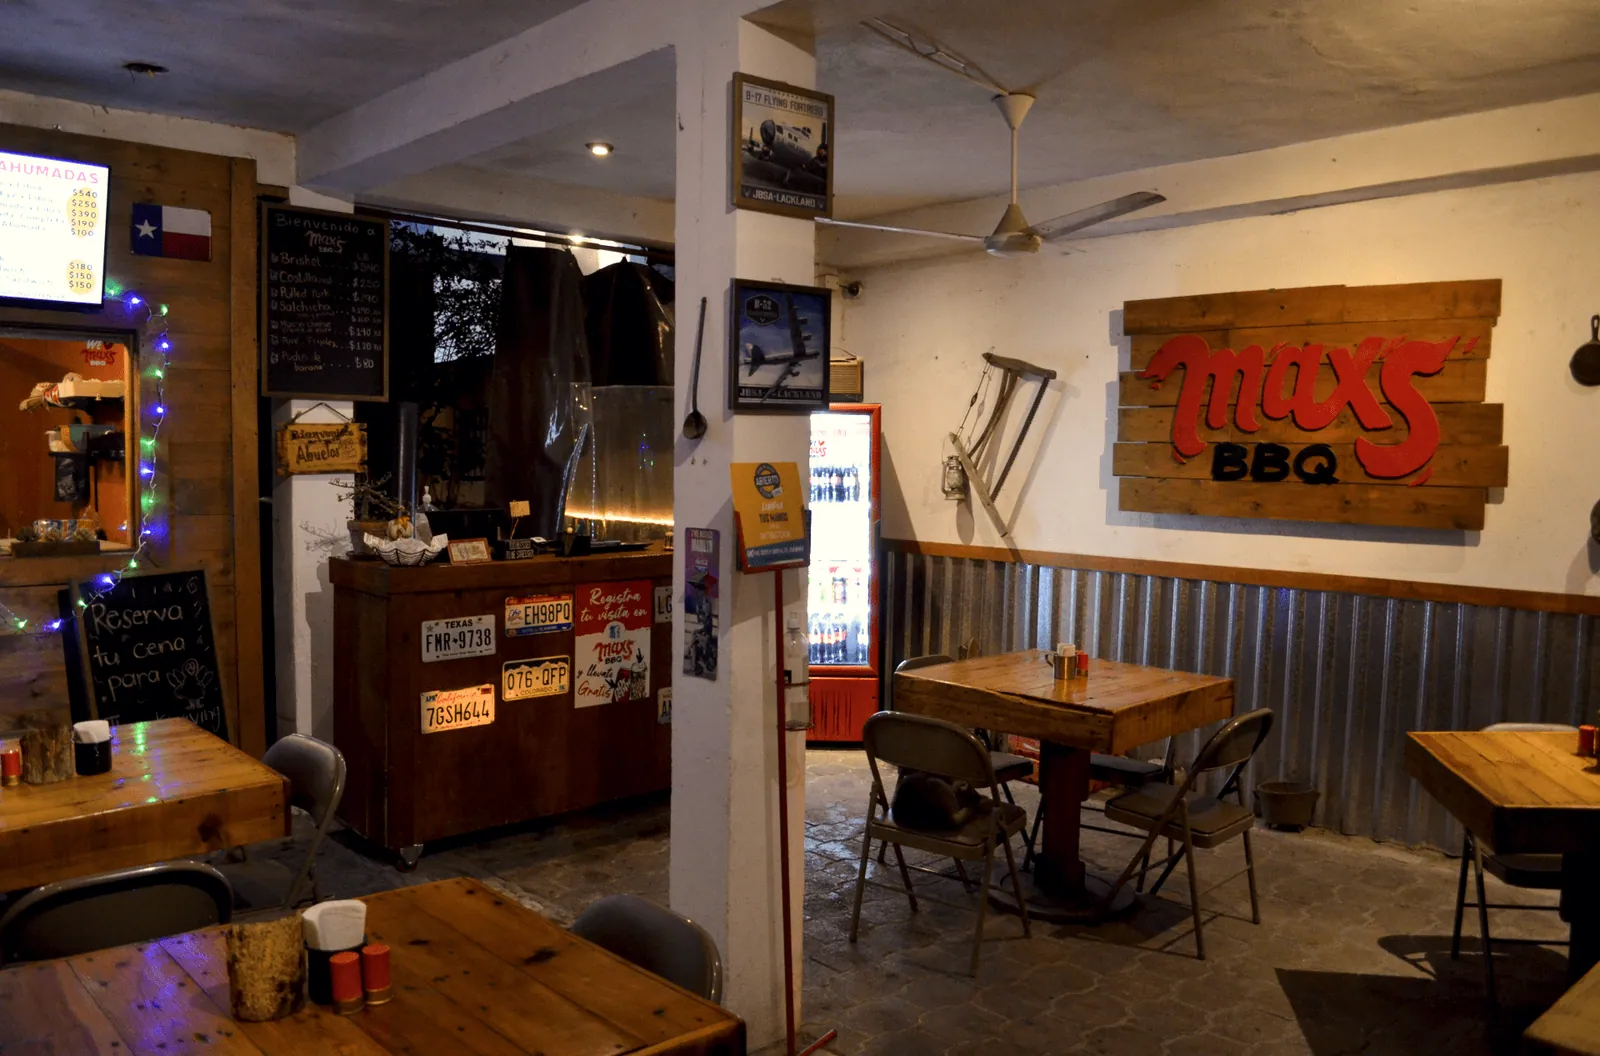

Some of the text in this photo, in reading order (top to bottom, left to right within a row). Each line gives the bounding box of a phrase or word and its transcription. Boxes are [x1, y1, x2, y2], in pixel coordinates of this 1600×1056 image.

[745, 90, 825, 117] B-17 FLYING FORTRESS
[0, 160, 99, 185] AHUMADAS
[73, 188, 98, 198] $540
[752, 190, 816, 208] JBSA-LACKLAND
[72, 199, 97, 209] $250
[71, 209, 97, 219] $390
[71, 218, 94, 228] $190
[274, 213, 375, 236] Bienvenido a
[71, 228, 94, 237] $100
[69, 262, 93, 271] $180
[280, 252, 320, 267] Brisket
[69, 271, 92, 280] $150
[68, 280, 92, 289] $150
[280, 301, 332, 313] Salchicha
[354, 356, 375, 369] $80
[1211, 442, 1339, 484] BBQ
[590, 587, 641, 609] Registra
[91, 603, 184, 635] Reserva
[524, 602, 570, 626] EH98PQ
[580, 604, 647, 622] tu visita en
[444, 619, 473, 630] TEXAS
[93, 637, 186, 667] tu cena
[605, 656, 622, 665] BBQ
[577, 664, 613, 679] y llevate
[107, 669, 160, 702] para
[521, 685, 553, 696] COLORADO
[577, 680, 611, 699] Gratis
[426, 700, 489, 727] 7GSH644
